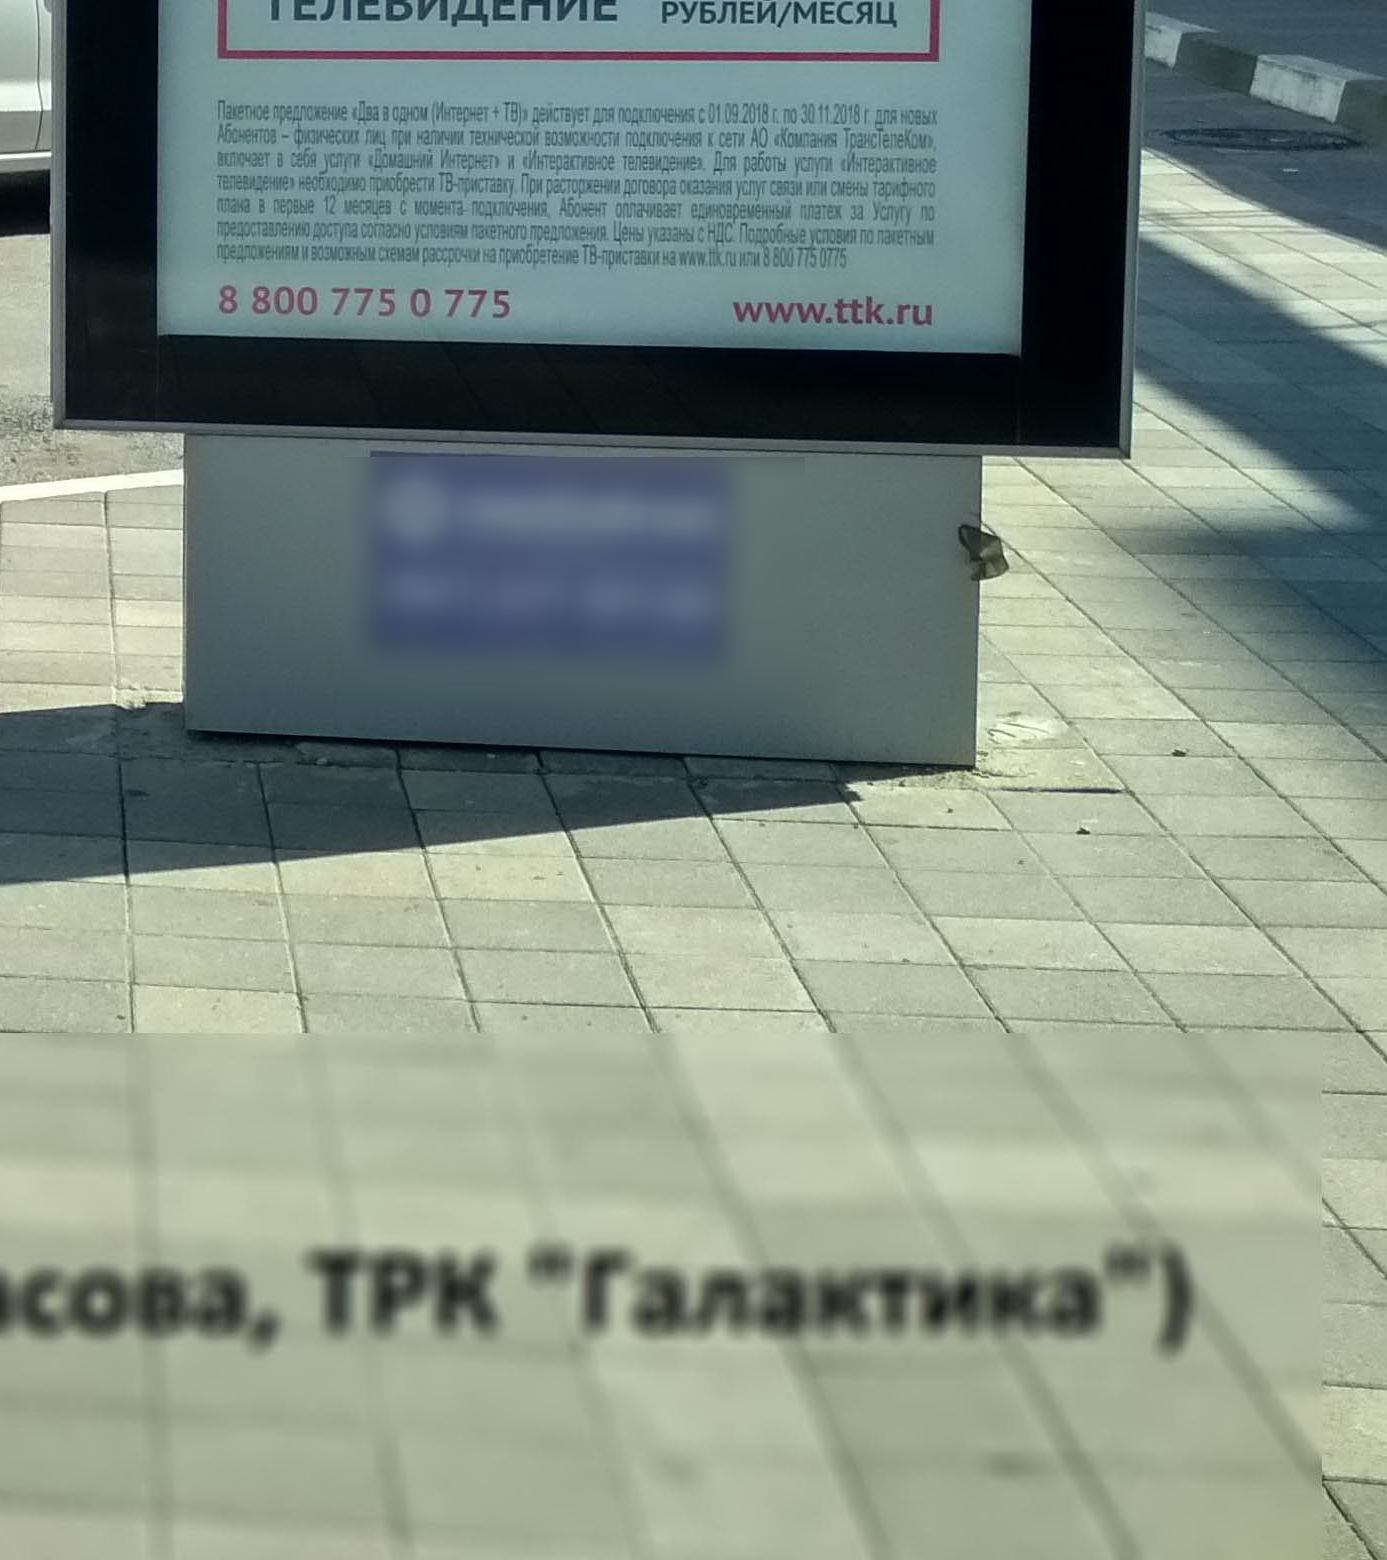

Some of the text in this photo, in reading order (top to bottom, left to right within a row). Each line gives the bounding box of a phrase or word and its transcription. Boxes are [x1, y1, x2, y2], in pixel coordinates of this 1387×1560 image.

[217, 99, 270, 121] Пакетное
[273, 105, 348, 126] предложение
[382, 105, 389, 122] в
[392, 105, 427, 125] одном
[531, 101, 590, 127] действует
[593, 107, 614, 126] для
[618, 107, 695, 127] подключения
[698, 107, 706, 124] с
[772, 108, 781, 124] г.
[783, 108, 797, 124] по
[874, 109, 897, 128] для
[900, 109, 939, 125] новых
[217, 123, 277, 144] Абонентов
[293, 124, 359, 150] физических
[365, 129, 386, 148] лиц
[391, 129, 411, 150] при
[417, 129, 464, 146] наличии
[469, 125, 540, 146] технической
[545, 130, 620, 147] возможности
[626, 131, 703, 150] подключения
[707, 131, 714, 148] к
[719, 131, 745, 148] сети
[750, 126, 768, 148] АО
[217, 151, 270, 168] включает
[277, 152, 283, 168] в
[290, 147, 317, 168] себя
[322, 152, 360, 173] услуги
[368, 148, 433, 172] «Домашний
[440, 148, 500, 174] Интернет»
[507, 153, 515, 170] и
[522, 149, 615, 175] «Интерактивное
[713, 150, 737, 175] Для
[743, 151, 787, 177] работы
[794, 156, 833, 177] услуги
[840, 152, 937, 178] «Интерактивное
[217, 175, 295, 194] телевидение»
[298, 170, 366, 195] необходимо
[369, 171, 434, 197] приобрести
[521, 172, 543, 198] При
[546, 178, 620, 199] расторжении
[623, 178, 676, 199] договора
[679, 179, 733, 195] оказания
[735, 179, 768, 200] услуг
[770, 180, 803, 196] связи
[805, 180, 827, 196] или
[830, 180, 868, 197] смены
[873, 176, 936, 202] тарифного
[217, 198, 251, 214] плана
[258, 198, 265, 215] в
[273, 198, 315, 219] первые
[323, 194, 337, 215] 12
[344, 199, 391, 219] месяцев
[399, 199, 407, 216] с
[414, 200, 463, 216] момента
[559, 196, 607, 218] Абонент
[615, 202, 683, 218] оплачивает
[691, 197, 791, 223] единовременный
[800, 203, 842, 220] платеж
[850, 203, 864, 220] за
[872, 199, 912, 225] Услугу
[920, 204, 935, 221] по
[217, 222, 310, 243] предоставлению
[313, 223, 358, 244] доступа
[361, 223, 411, 240] согласно
[414, 224, 468, 245] условиям
[471, 224, 527, 241] пакетного
[613, 221, 644, 245] Цены
[647, 226, 695, 247] указаны
[697, 227, 705, 243] с
[739, 222, 806, 248] Подробные
[809, 228, 857, 249] условия
[859, 228, 874, 245] по
[877, 229, 935, 245] пакетным
[217, 243, 847, 270] предложениям и возможным схемам рассрочки на приобретение ТВ-приставки на www.ttk.ru или 8 800 775 0775
[218, 284, 511, 319] 8 800 775 0 775
[733, 297, 934, 326] www.ttk.ru
